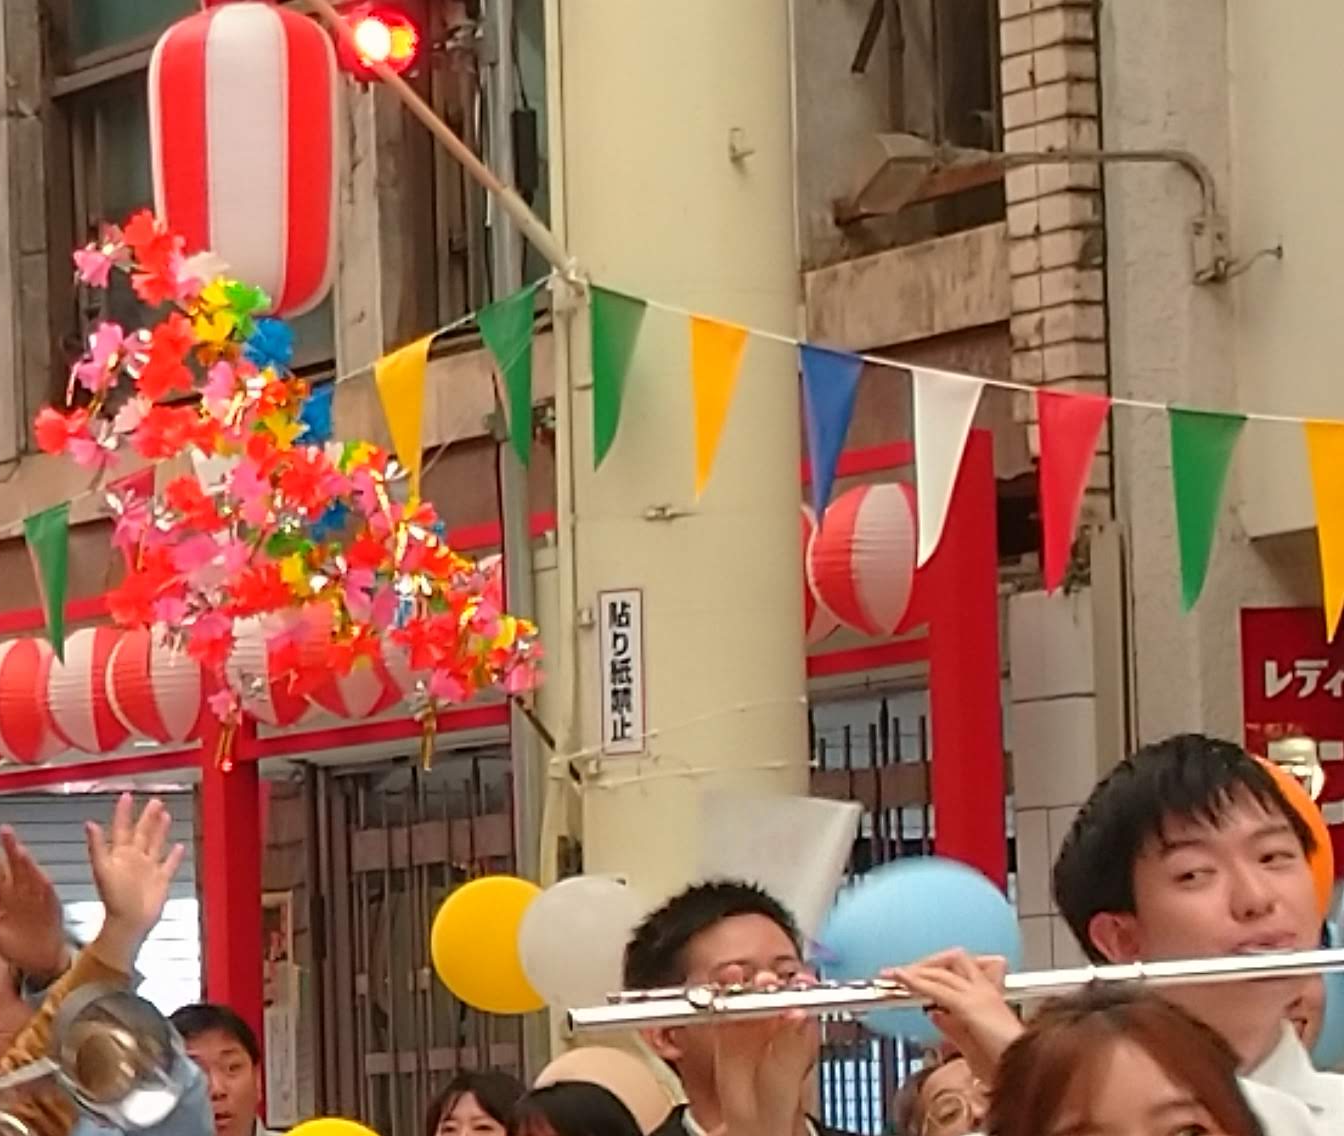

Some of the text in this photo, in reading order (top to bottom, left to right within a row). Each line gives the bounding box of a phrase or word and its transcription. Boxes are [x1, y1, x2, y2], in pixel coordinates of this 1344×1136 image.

[608, 601, 633, 742] 貼り紙禁止
